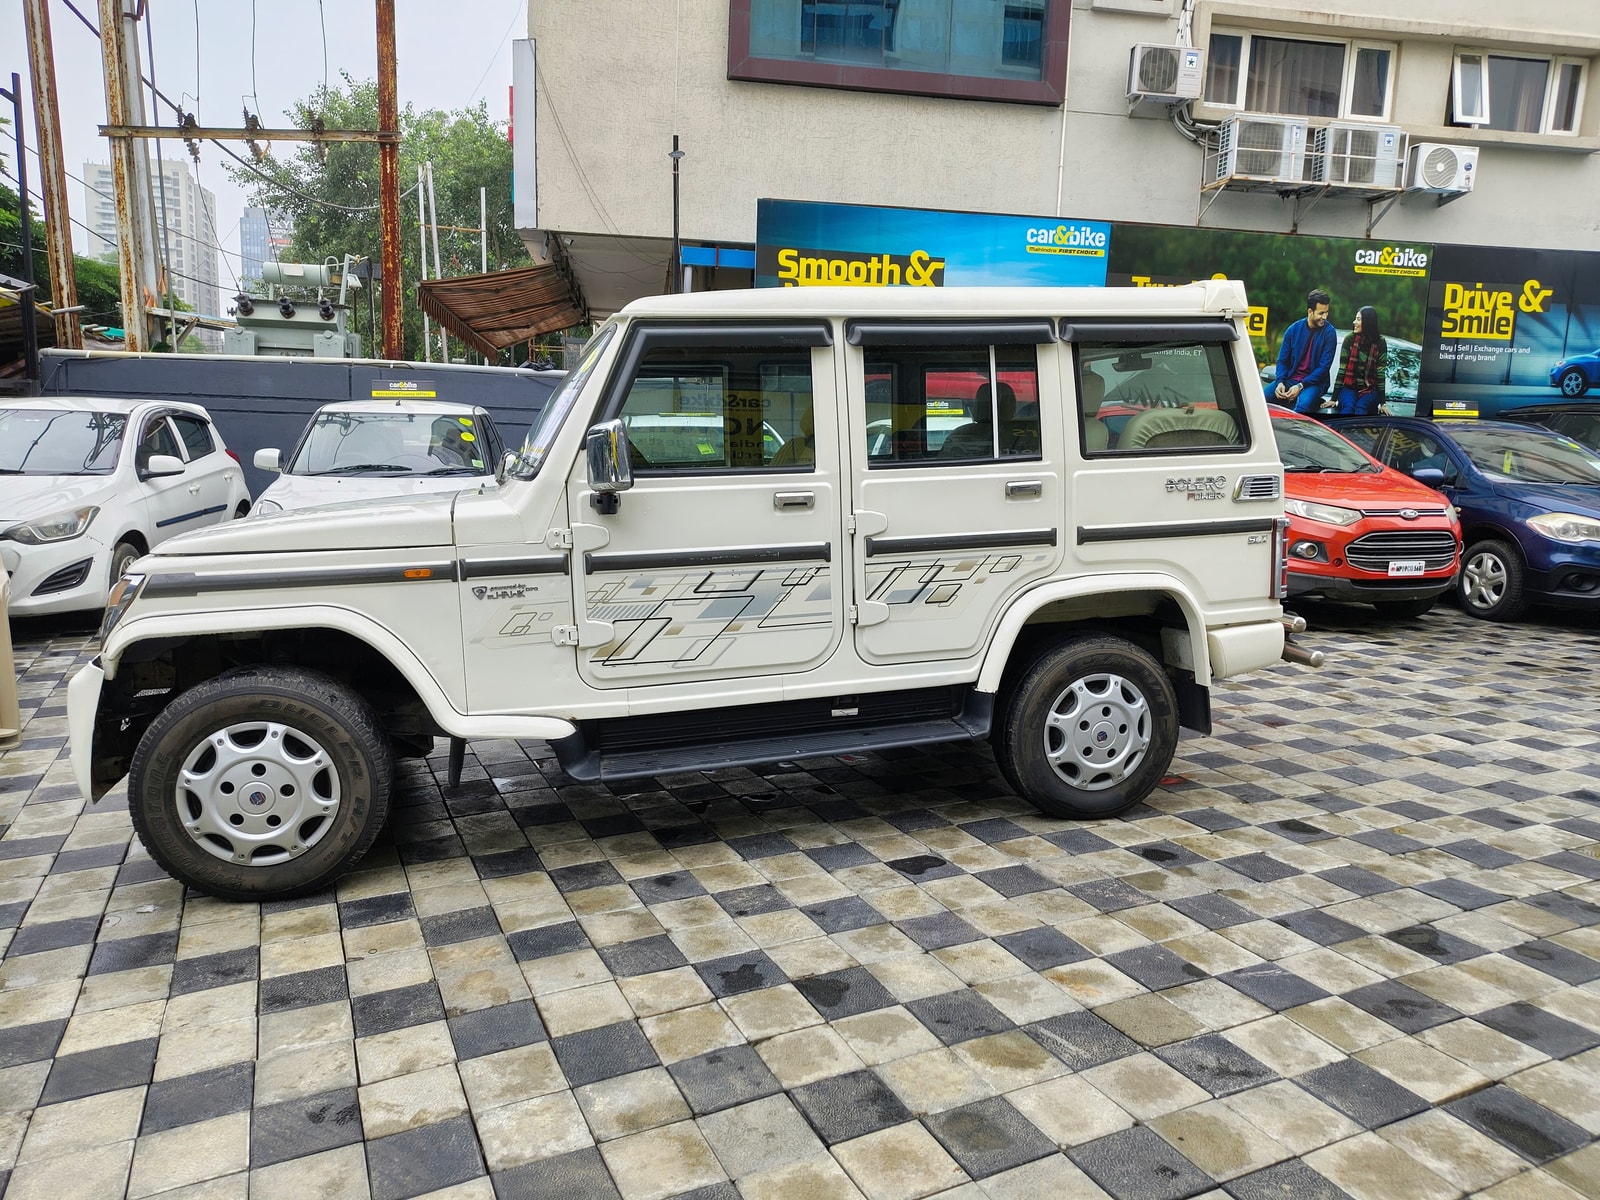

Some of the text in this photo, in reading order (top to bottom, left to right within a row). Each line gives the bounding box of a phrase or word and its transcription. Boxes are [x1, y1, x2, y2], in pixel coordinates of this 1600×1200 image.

[1026, 225, 1106, 247] car&bike
[778, 248, 946, 287] Smooth &
[1355, 246, 1428, 268] car&bike
[1443, 279, 1554, 313] Drive &
[1442, 308, 1511, 335] Smile
[1439, 352, 1456, 360] bikes
[1440, 343, 1454, 352] Buy
[1473, 344, 1503, 354] Exchange
[1165, 475, 1227, 493] BOLERO
